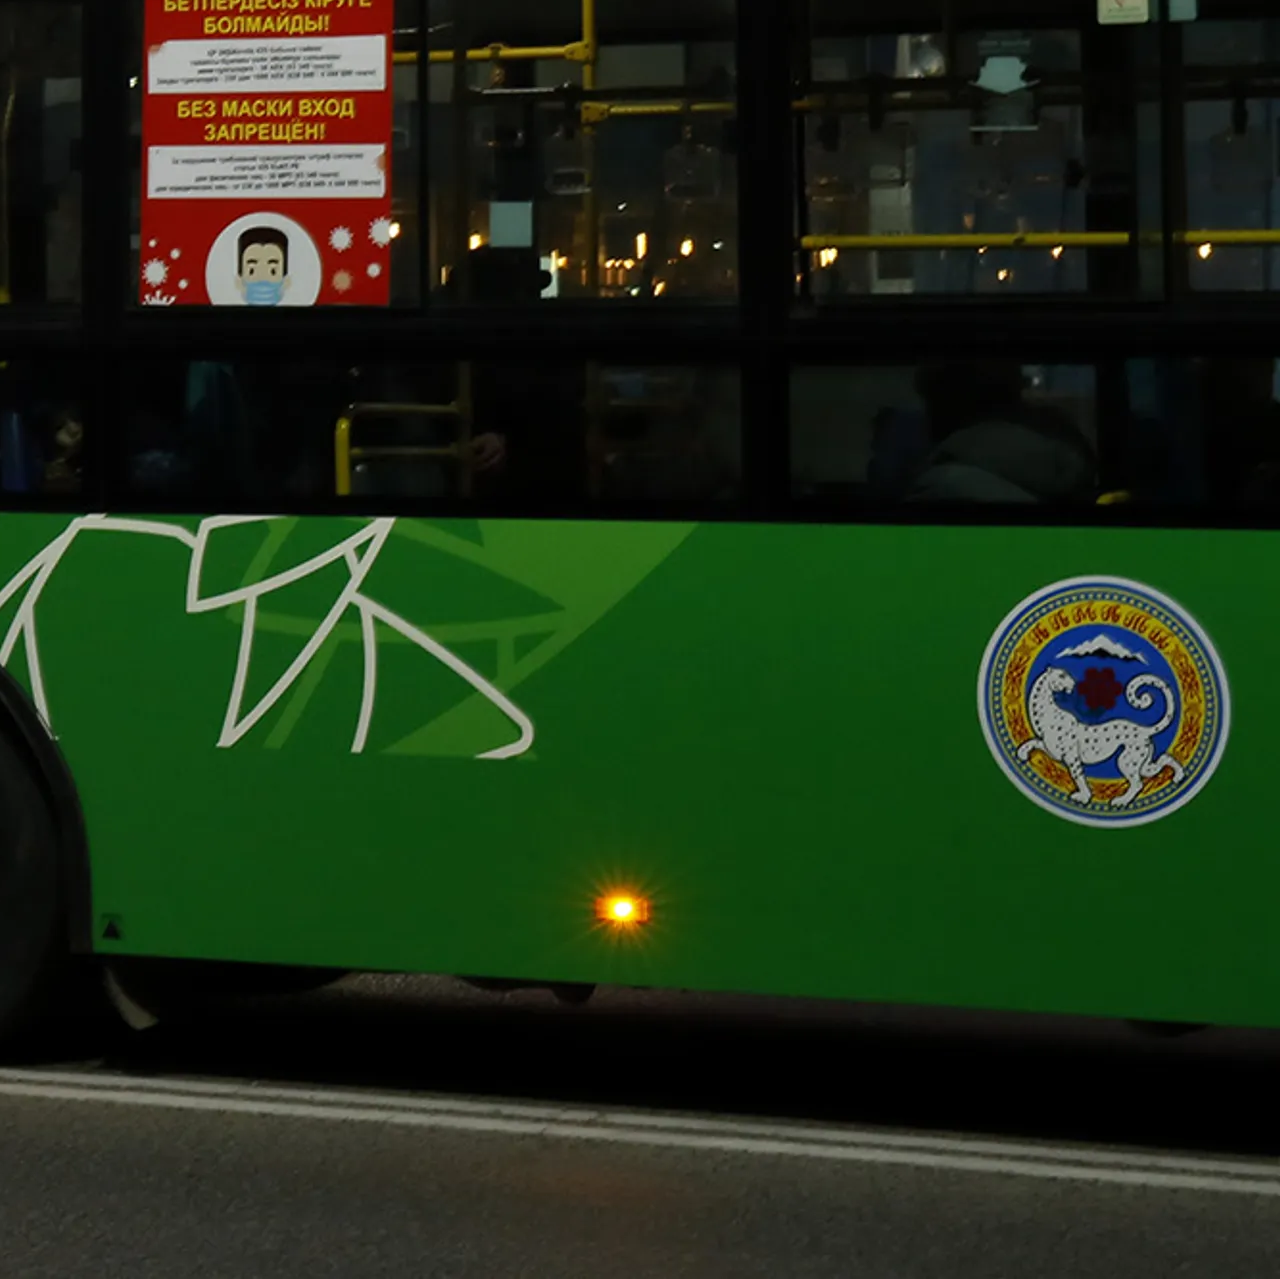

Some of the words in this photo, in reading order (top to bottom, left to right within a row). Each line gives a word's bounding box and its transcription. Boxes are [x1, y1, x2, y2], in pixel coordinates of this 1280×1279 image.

[203, 13, 330, 35] БОЛМАЙДЫ!
[177, 99, 216, 119] БЕЗ
[222, 99, 293, 117] МАСКИ
[299, 98, 355, 119] ВХОД
[204, 119, 326, 144] ЗАПРЕЩЁН!
